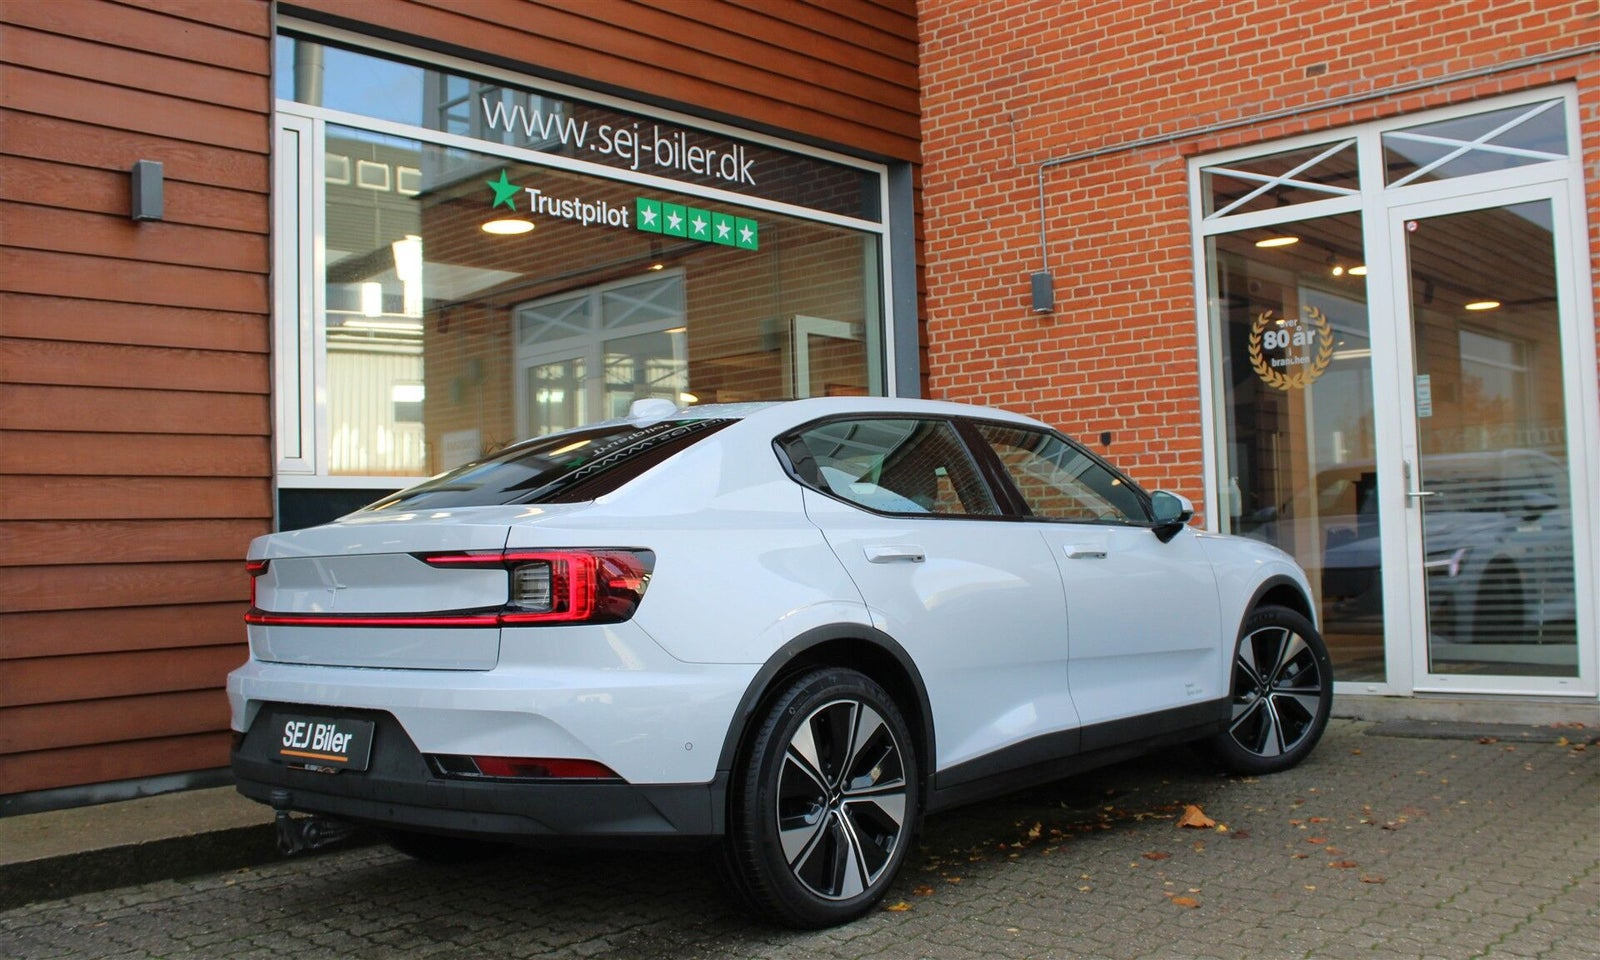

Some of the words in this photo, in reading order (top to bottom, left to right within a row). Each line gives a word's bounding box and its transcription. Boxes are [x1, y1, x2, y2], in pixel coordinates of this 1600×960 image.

[482, 97, 756, 185] www.sej-biler.dk
[525, 188, 629, 228] Trustpilot
[1263, 329, 1290, 350] 80
[1293, 325, 1316, 346] år
[282, 720, 313, 748] SEJ
[312, 723, 352, 753] Biler
